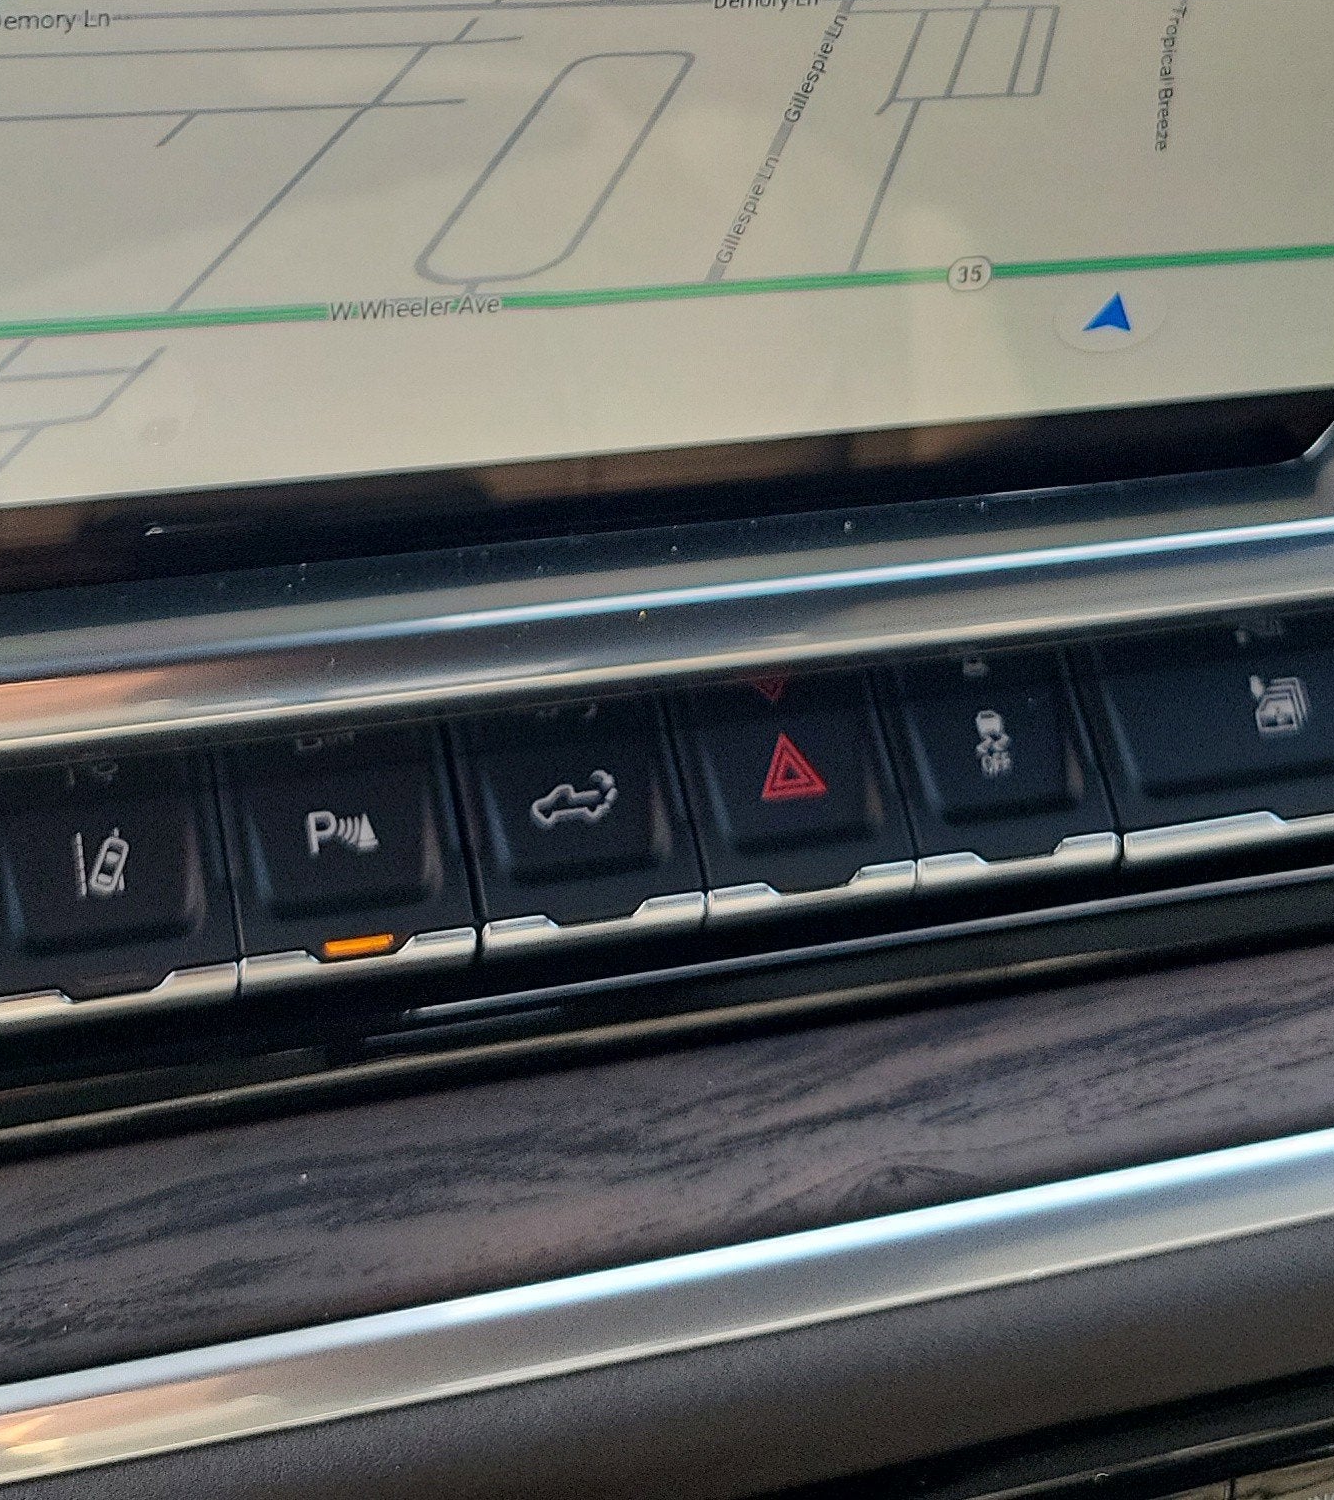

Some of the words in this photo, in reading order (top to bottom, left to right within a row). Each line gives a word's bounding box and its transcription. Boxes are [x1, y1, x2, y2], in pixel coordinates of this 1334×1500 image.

[83, 8, 111, 30] Ln
[1159, 5, 1188, 82] Tropical
[783, 41, 834, 124] Gillespie
[824, 13, 849, 40] Ln
[1154, 86, 1174, 152] Breeze
[717, 183, 766, 264] Gillespie
[756, 155, 780, 181] Ln
[955, 263, 984, 285] 35
[330, 300, 353, 322] W
[359, 296, 453, 320] Wheeler
[458, 294, 501, 316] Ave
